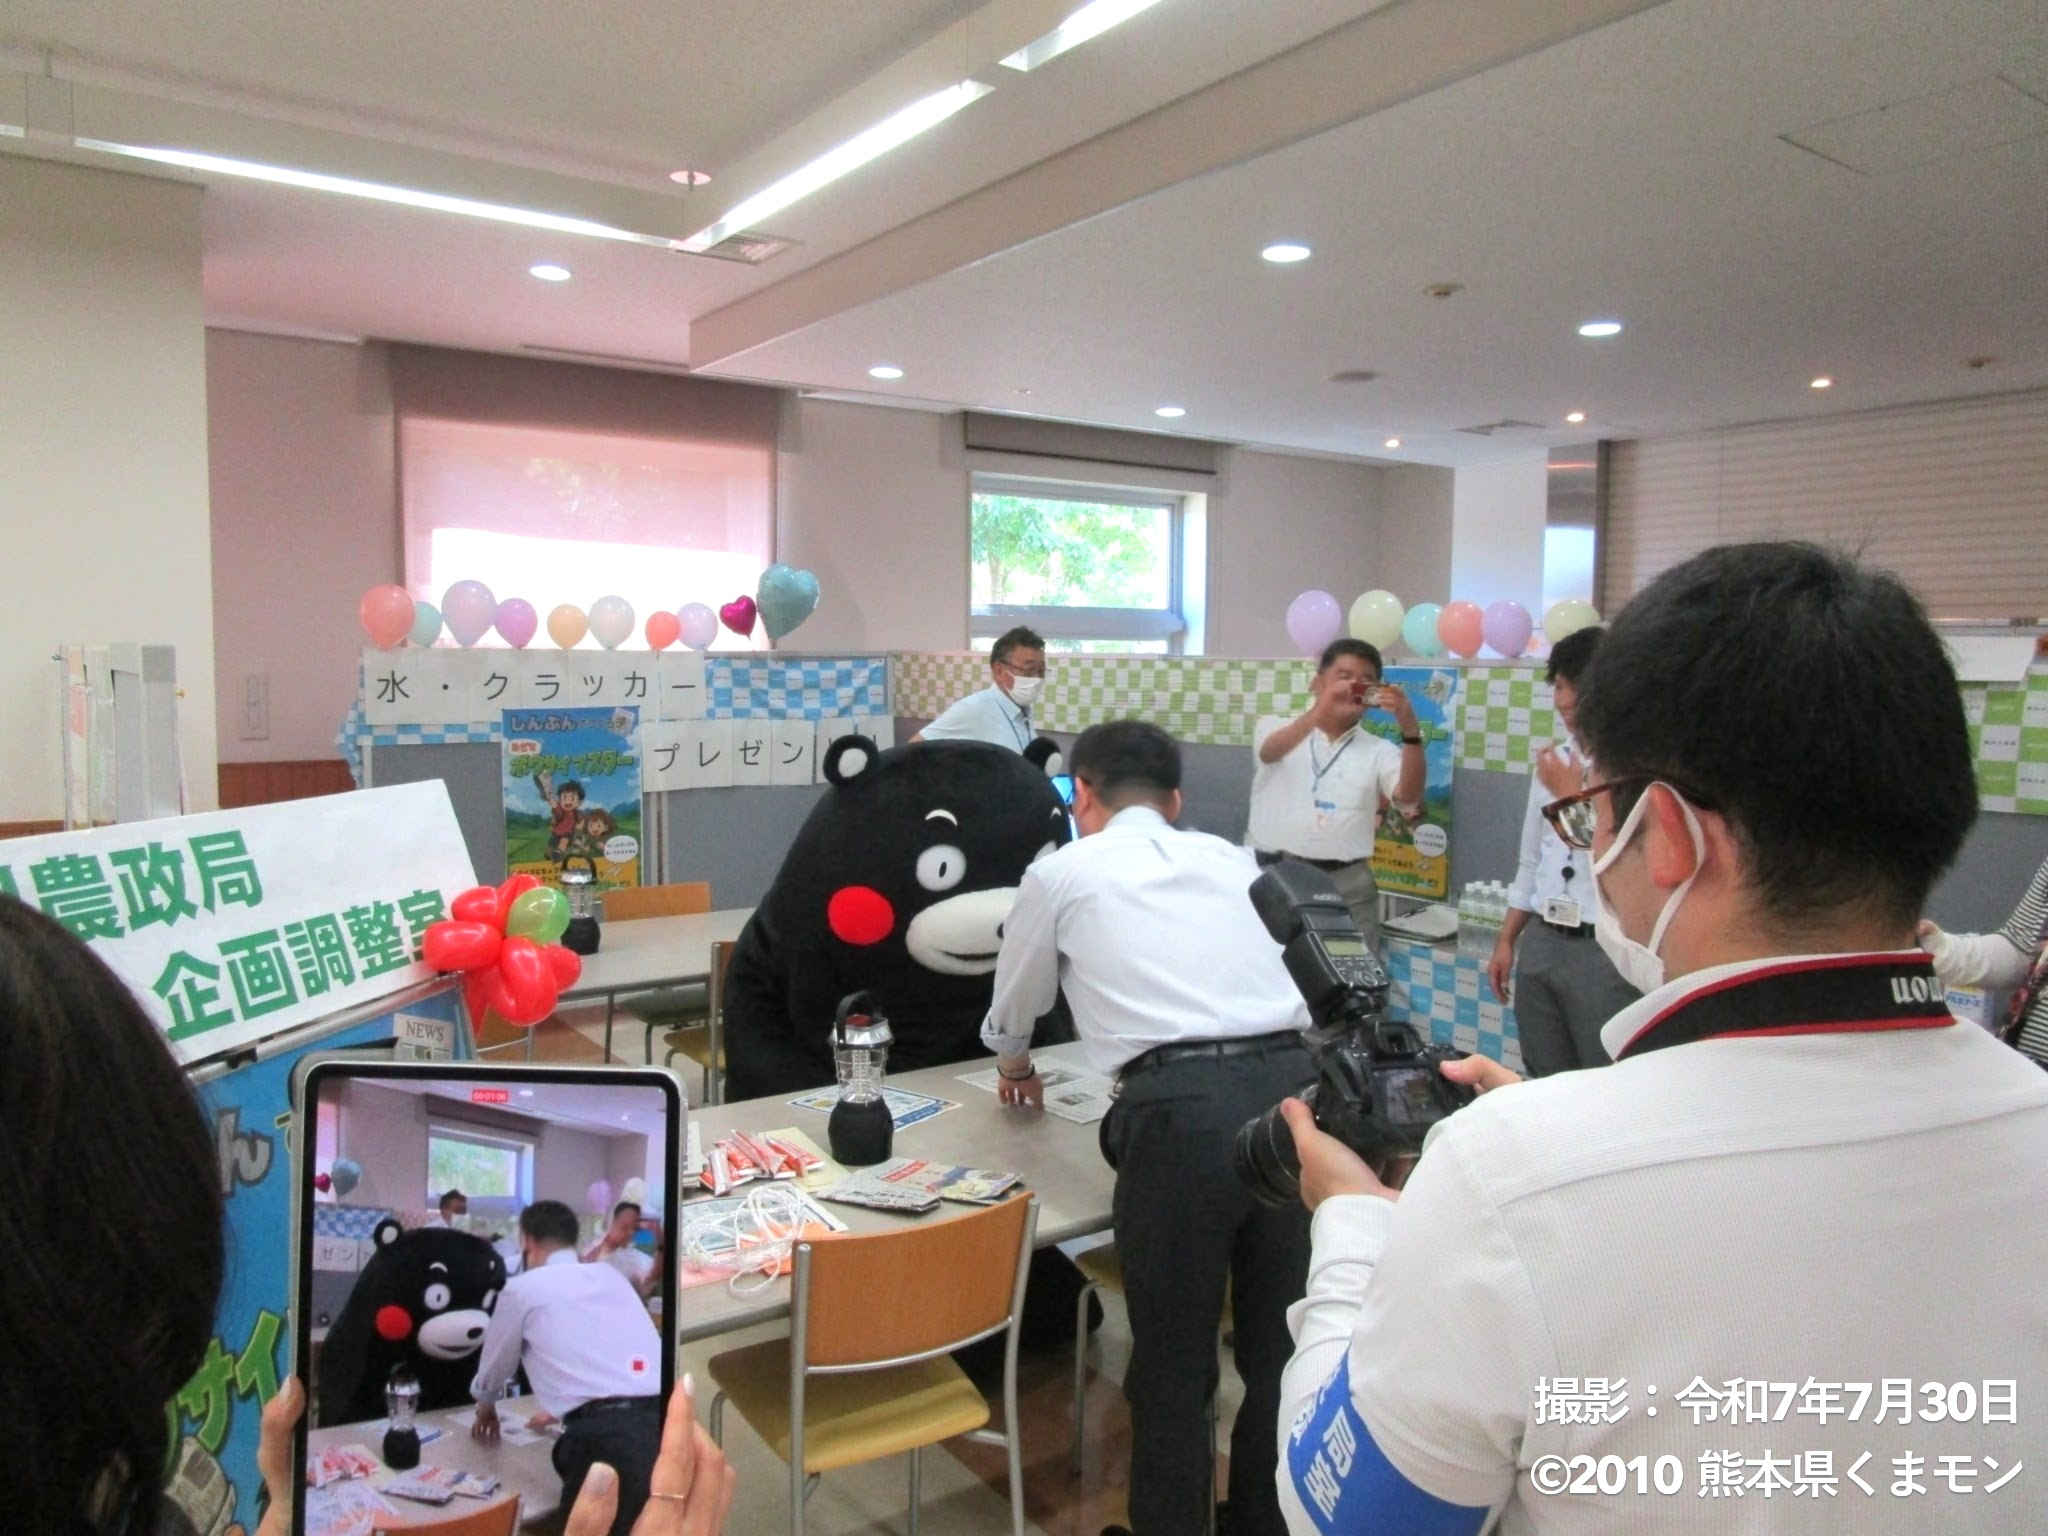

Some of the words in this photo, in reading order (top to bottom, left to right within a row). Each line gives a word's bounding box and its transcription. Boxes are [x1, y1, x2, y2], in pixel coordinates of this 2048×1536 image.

[377, 670, 696, 703] 水・クラッカー
[654, 734, 876, 772] プレゼン
[0, 830, 263, 940] 農政局
[406, 1020, 444, 1042] NEWS
[165, 1309, 282, 1480] サイ
